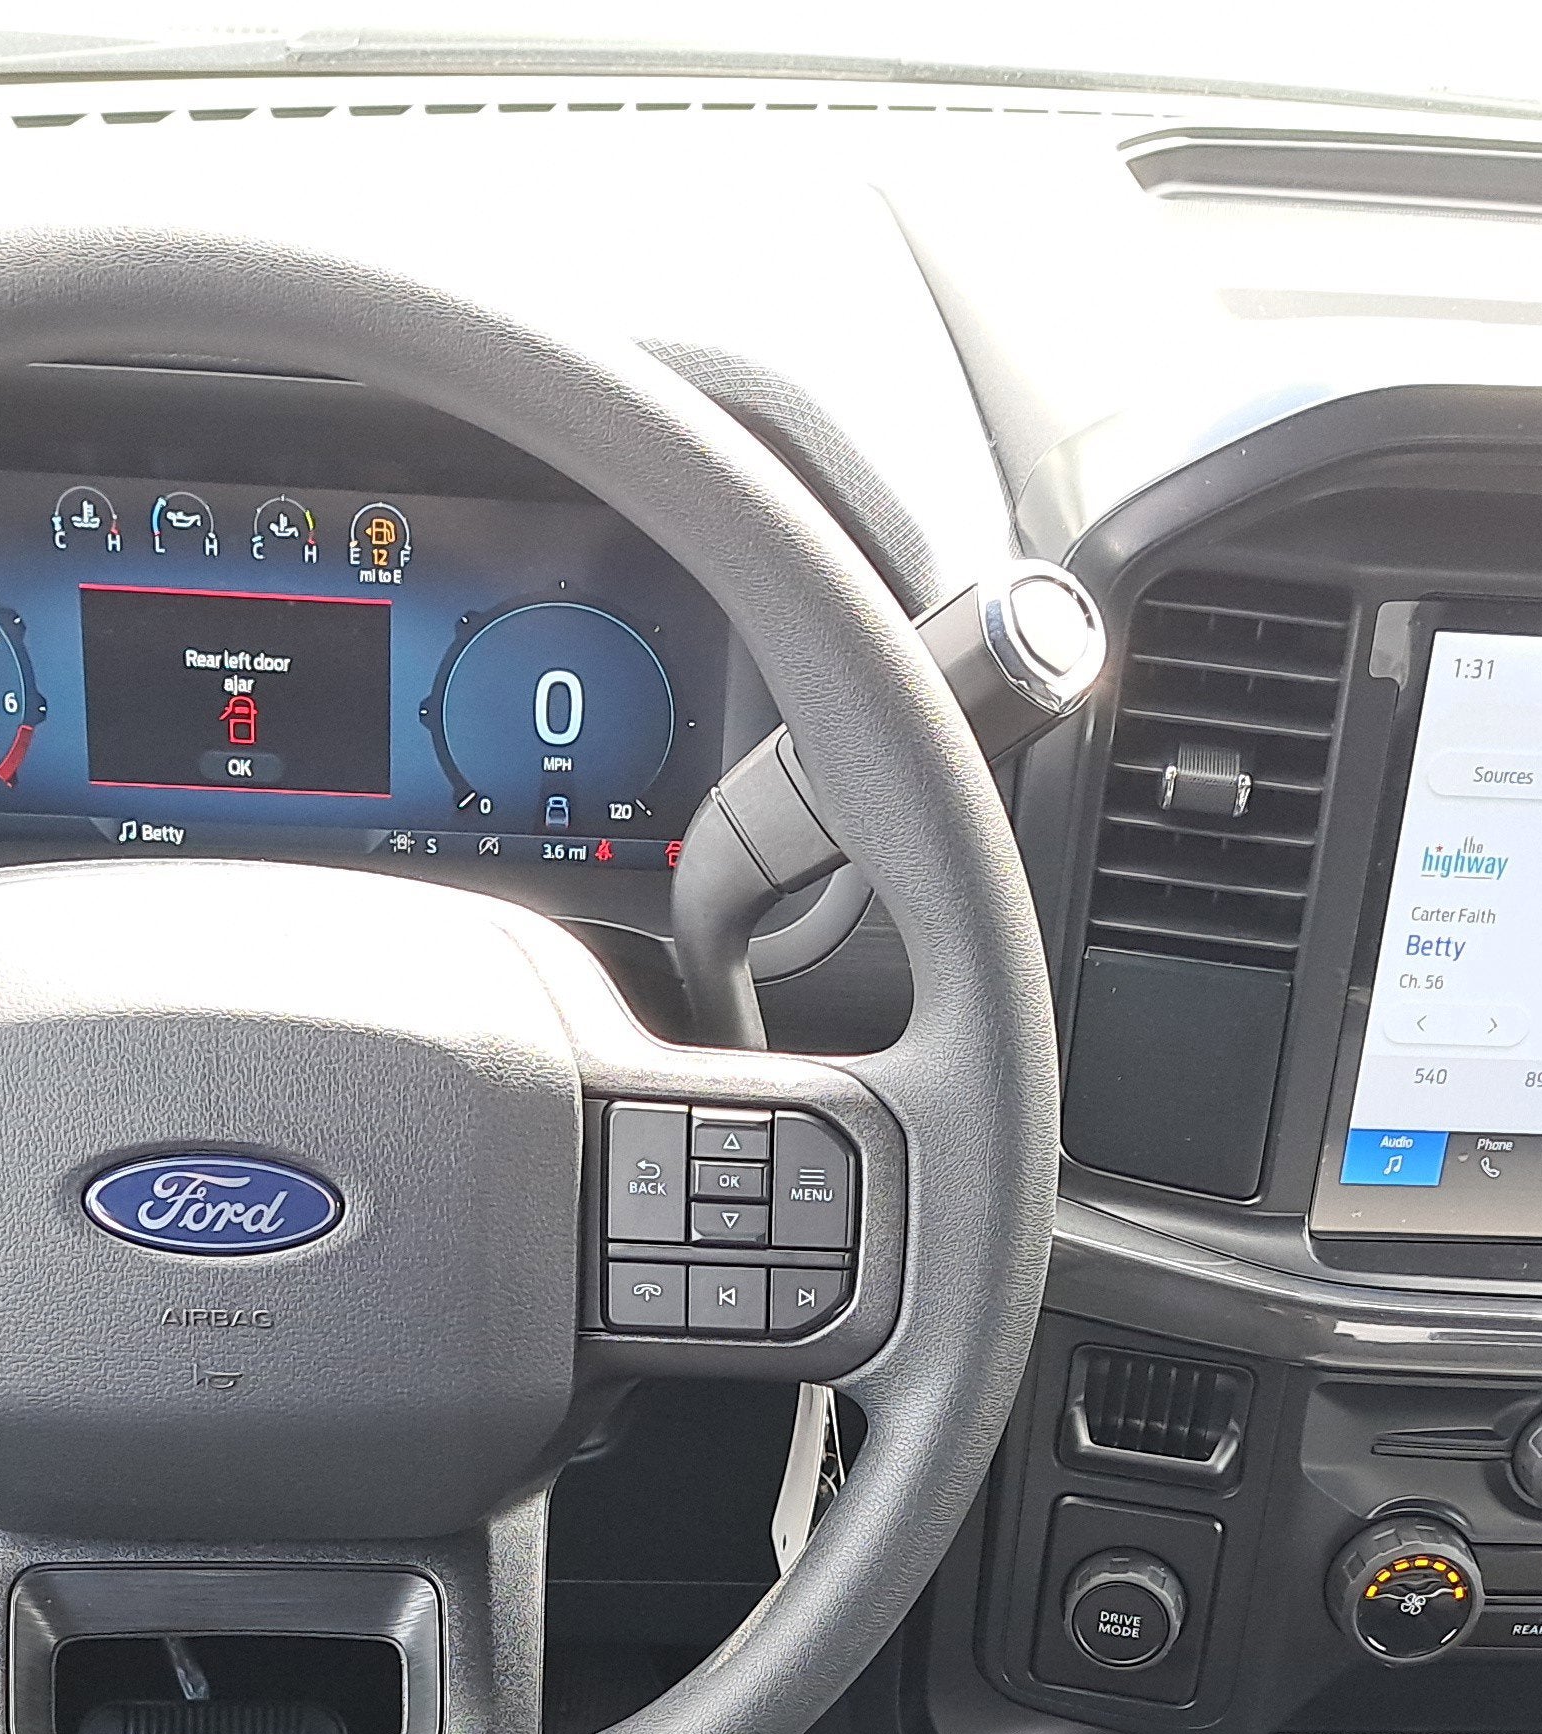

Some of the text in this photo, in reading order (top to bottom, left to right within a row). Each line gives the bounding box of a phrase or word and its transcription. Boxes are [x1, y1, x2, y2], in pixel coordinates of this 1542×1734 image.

[54, 531, 67, 549] C
[108, 534, 121, 553] H
[154, 535, 166, 553] L
[205, 538, 218, 557] H
[253, 540, 264, 560] C
[304, 544, 317, 565] H
[349, 547, 362, 565] E
[372, 548, 388, 566] 12
[400, 549, 411, 568] F
[359, 568, 403, 584] mi to E
[185, 649, 292, 673] Rear left door
[1454, 658, 1495, 680] 1:31
[223, 675, 255, 695] ajar
[4, 692, 18, 713] 6
[534, 668, 585, 746] 0
[227, 758, 253, 777] OK
[543, 756, 573, 772] MPH
[1473, 766, 1534, 785] Sources
[479, 798, 492, 815] 0
[609, 802, 633, 820] 120
[141, 823, 185, 845] Betty
[425, 837, 437, 854] S
[542, 843, 587, 861] 3.6 mi
[1463, 836, 1484, 854] the
[1421, 846, 1509, 880] highway
[1411, 906, 1496, 925] Carter Faith
[1405, 934, 1467, 962] Betty
[1399, 973, 1444, 990] Ch. 56
[1413, 1067, 1448, 1085] 540
[1379, 1135, 1415, 1149] Audio
[1477, 1138, 1515, 1151] Phone
[628, 1182, 667, 1196] BACK
[719, 1174, 740, 1188] OK
[137, 1170, 289, 1234] Ford
[790, 1188, 833, 1202] MENU
[161, 1306, 275, 1329] AIRBAG
[1100, 1610, 1141, 1627] DRIVE
[1098, 1621, 1140, 1638] MODE
